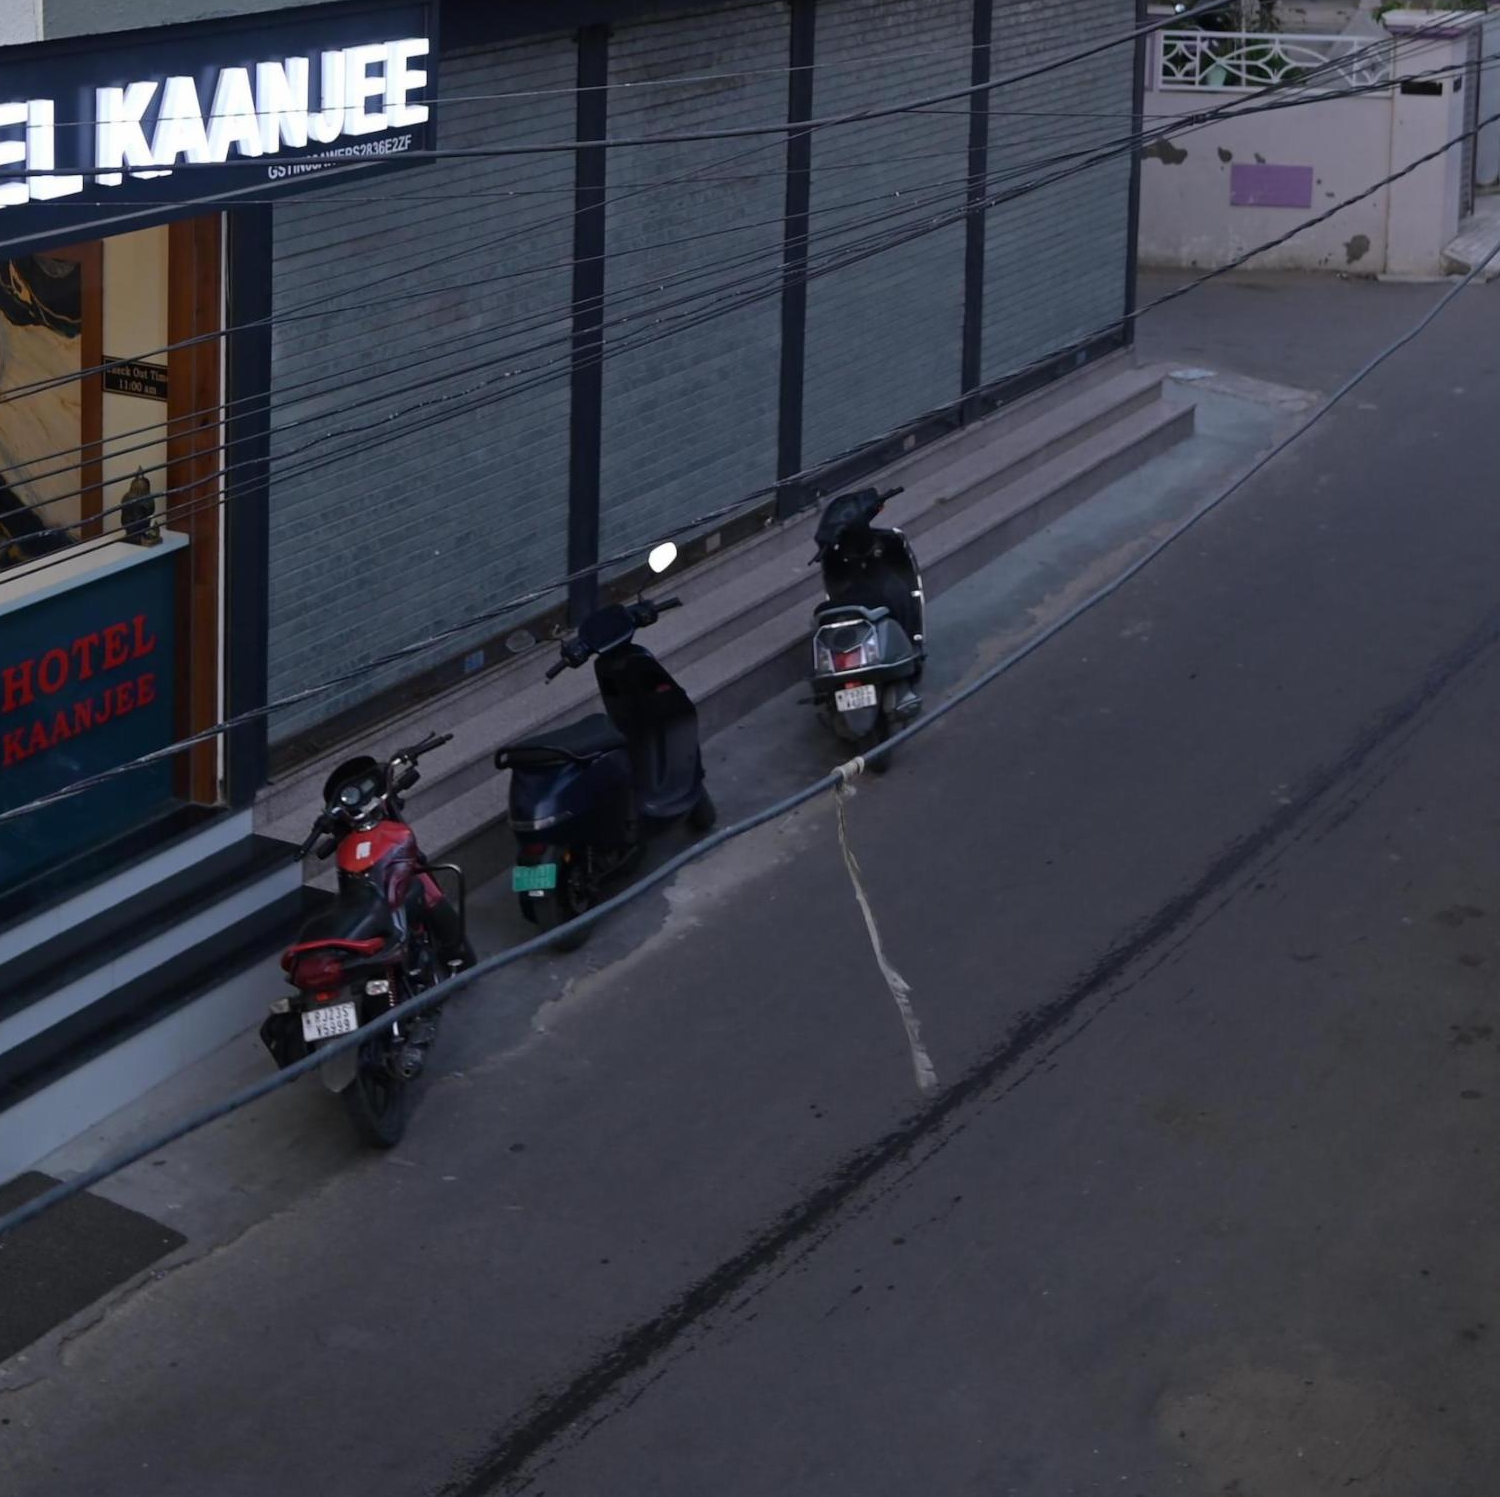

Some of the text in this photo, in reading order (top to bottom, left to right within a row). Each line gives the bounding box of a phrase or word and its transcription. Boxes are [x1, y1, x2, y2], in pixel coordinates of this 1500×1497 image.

[95, 37, 431, 187] KAANJEE
[1, 614, 158, 714] HOTEL
[2, 672, 157, 767] KAANJEE
